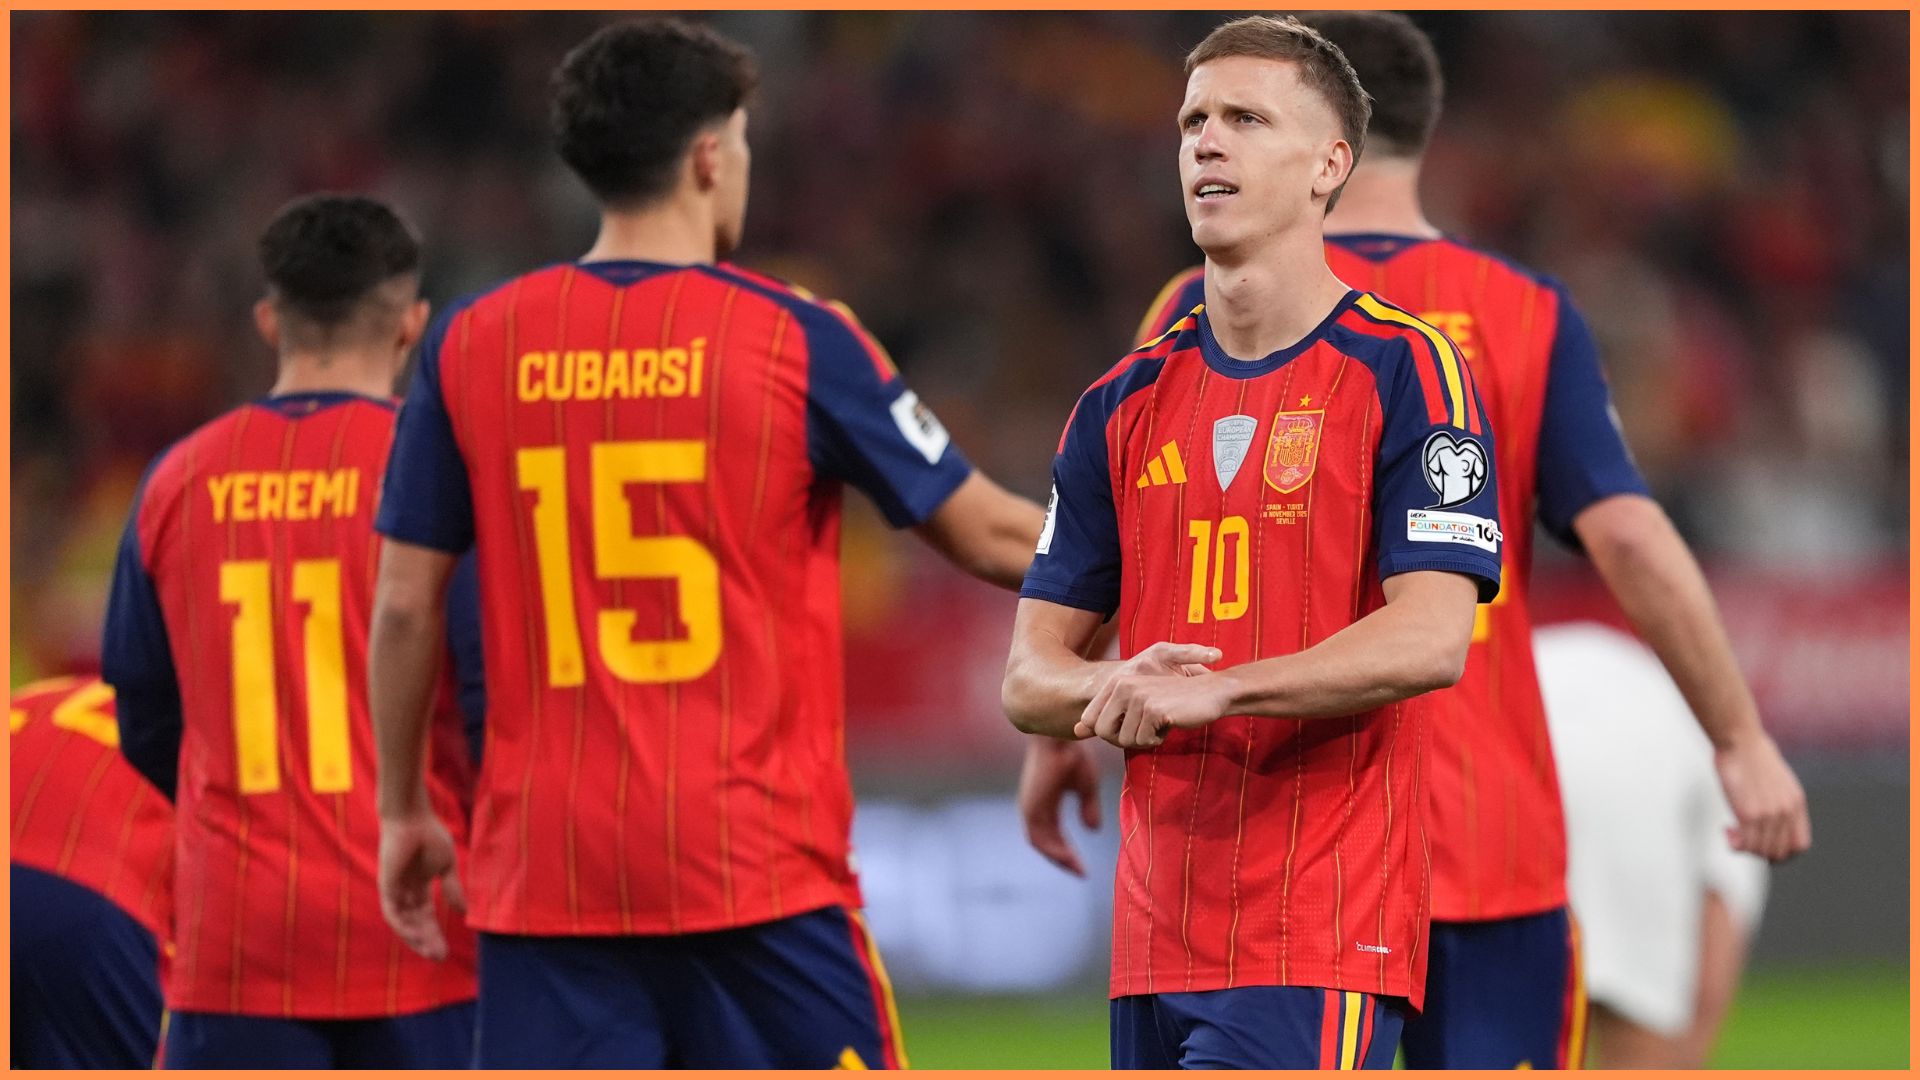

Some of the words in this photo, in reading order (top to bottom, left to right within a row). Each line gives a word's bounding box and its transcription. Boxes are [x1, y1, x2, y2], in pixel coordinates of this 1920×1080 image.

[518, 338, 707, 402] CUBARSÍ
[1217, 433, 1250, 441] CHAMPIONS
[1218, 426, 1252, 434] EUROPEAN
[207, 467, 360, 523] YEREMI
[1275, 517, 1296, 525] SEVILLE
[1410, 521, 1475, 534] FOUNDATION
[517, 440, 723, 688] 15
[1187, 515, 1250, 624] 10
[219, 557, 354, 794] 11
